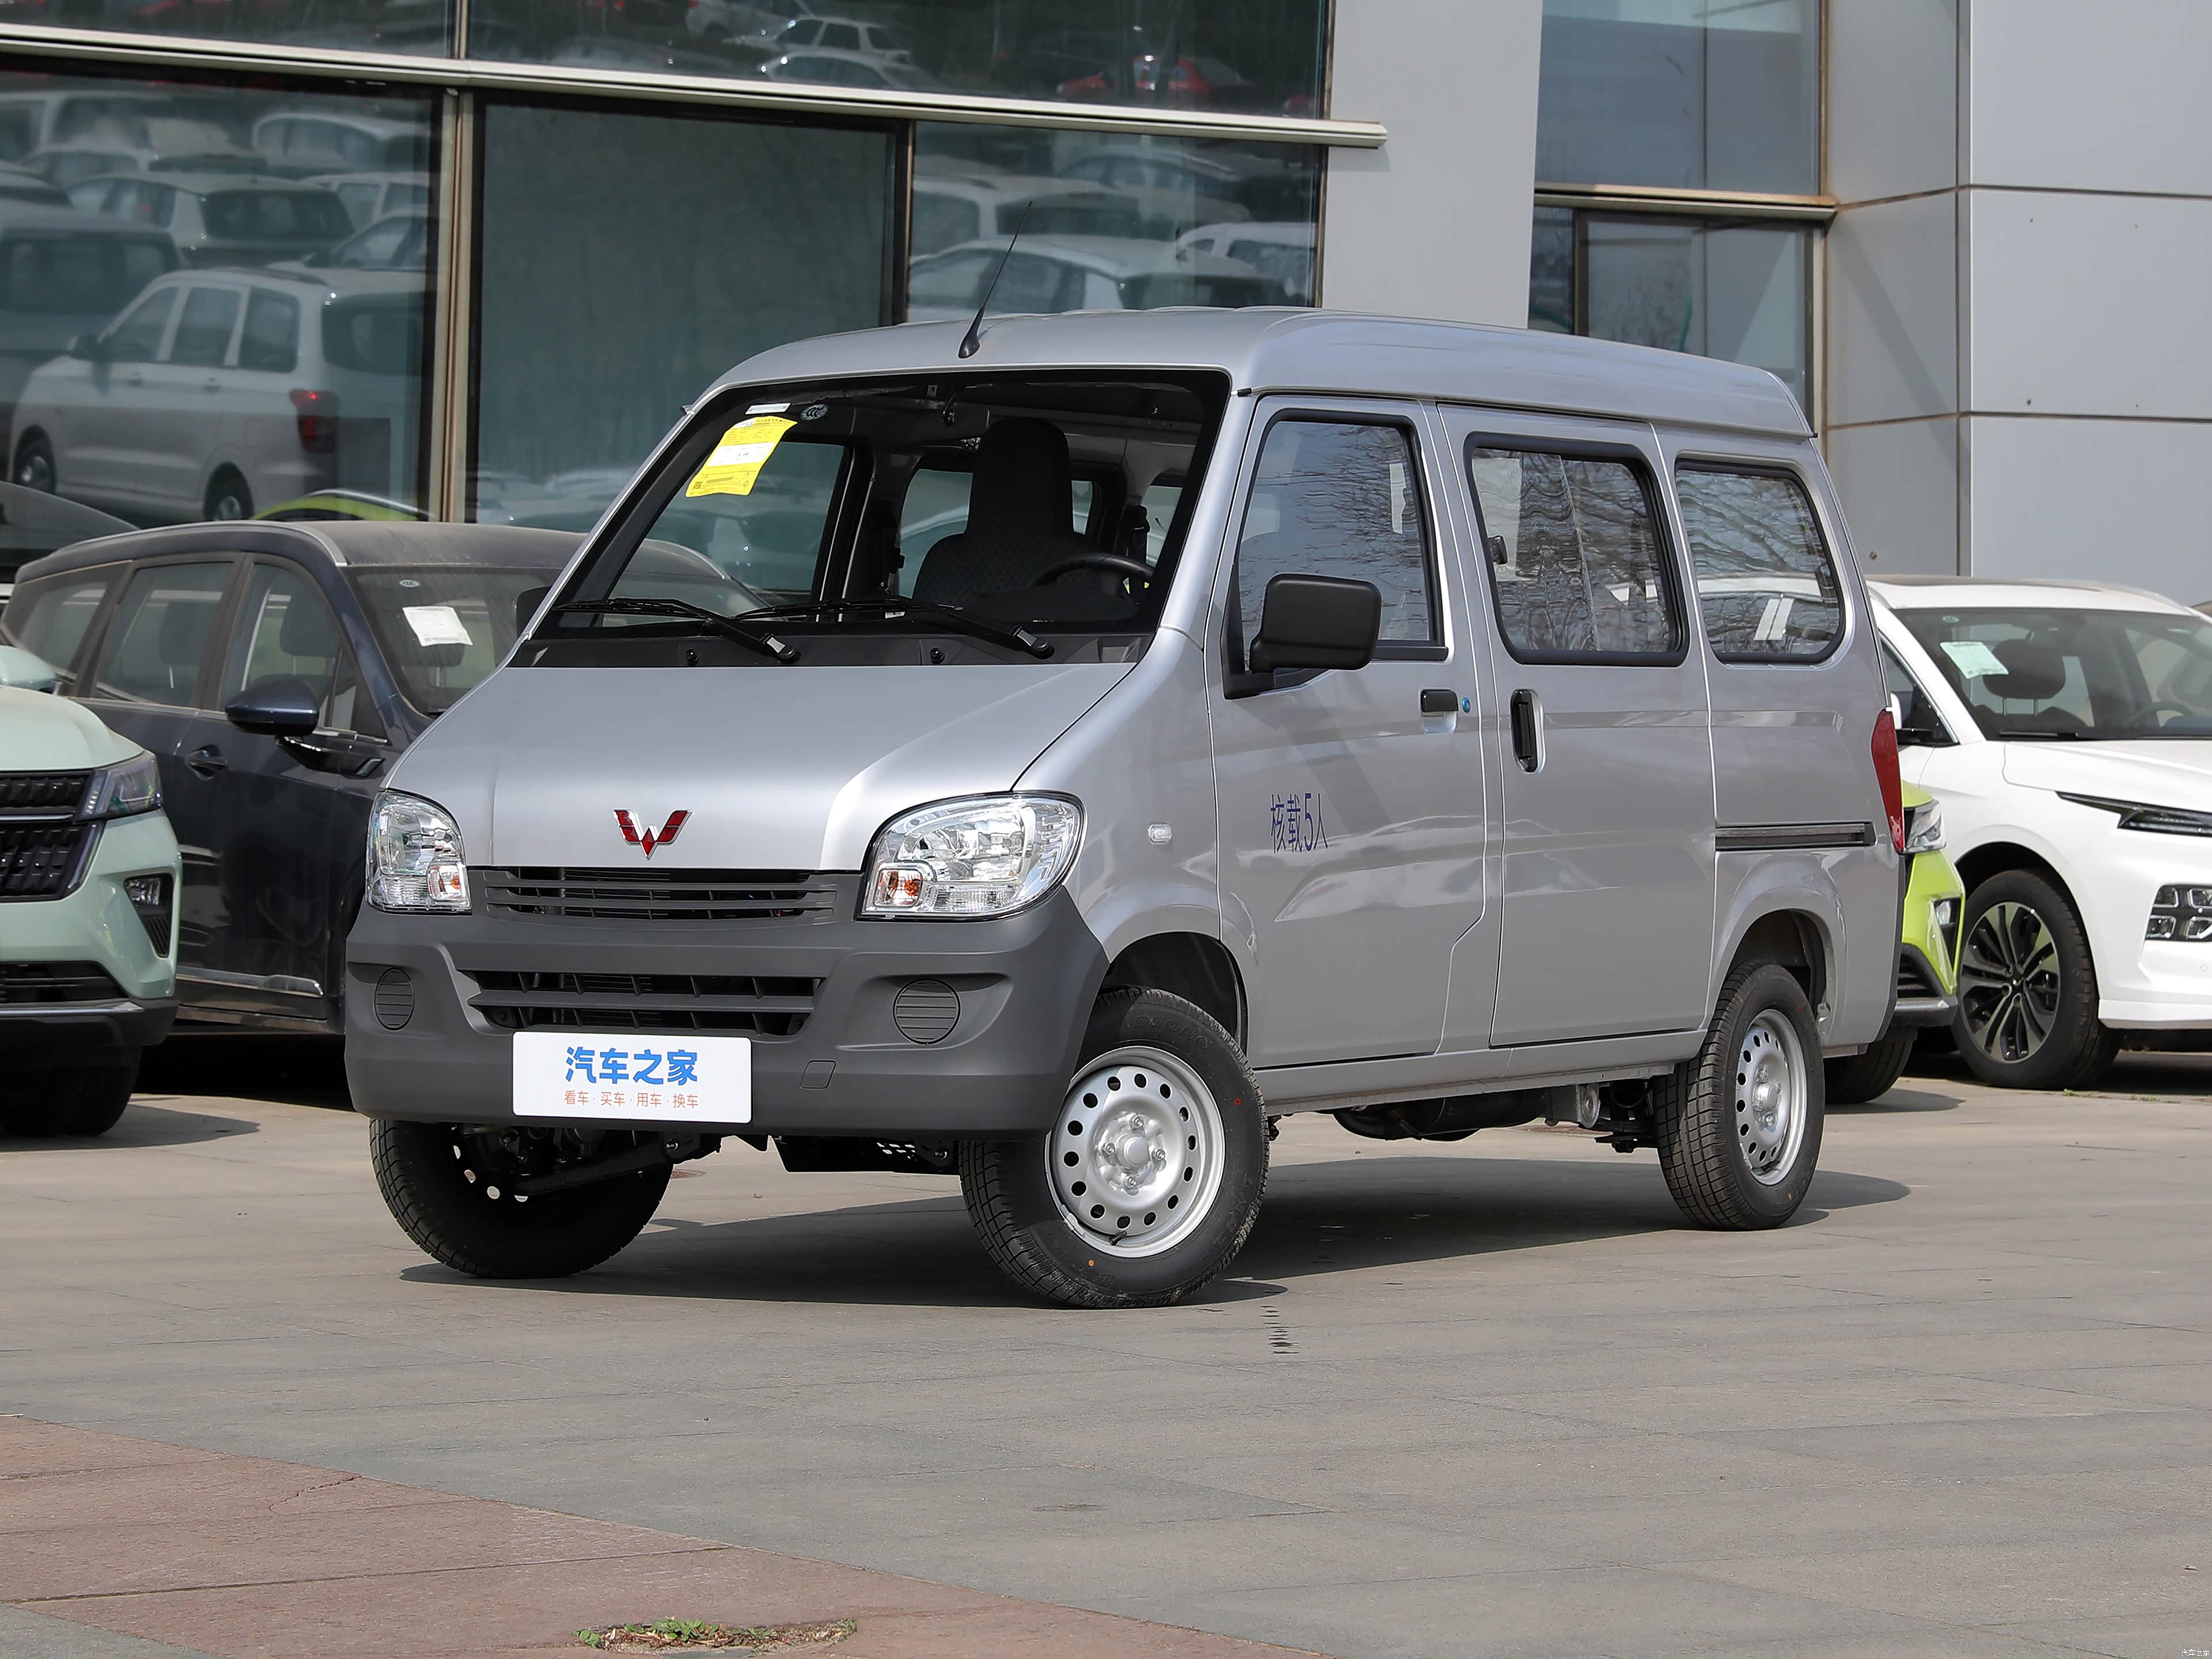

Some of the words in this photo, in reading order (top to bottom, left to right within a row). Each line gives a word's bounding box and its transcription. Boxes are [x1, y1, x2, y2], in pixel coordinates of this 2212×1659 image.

[1270, 793, 1328, 854] 核载5人
[565, 1047, 698, 1085] 汽车之家
